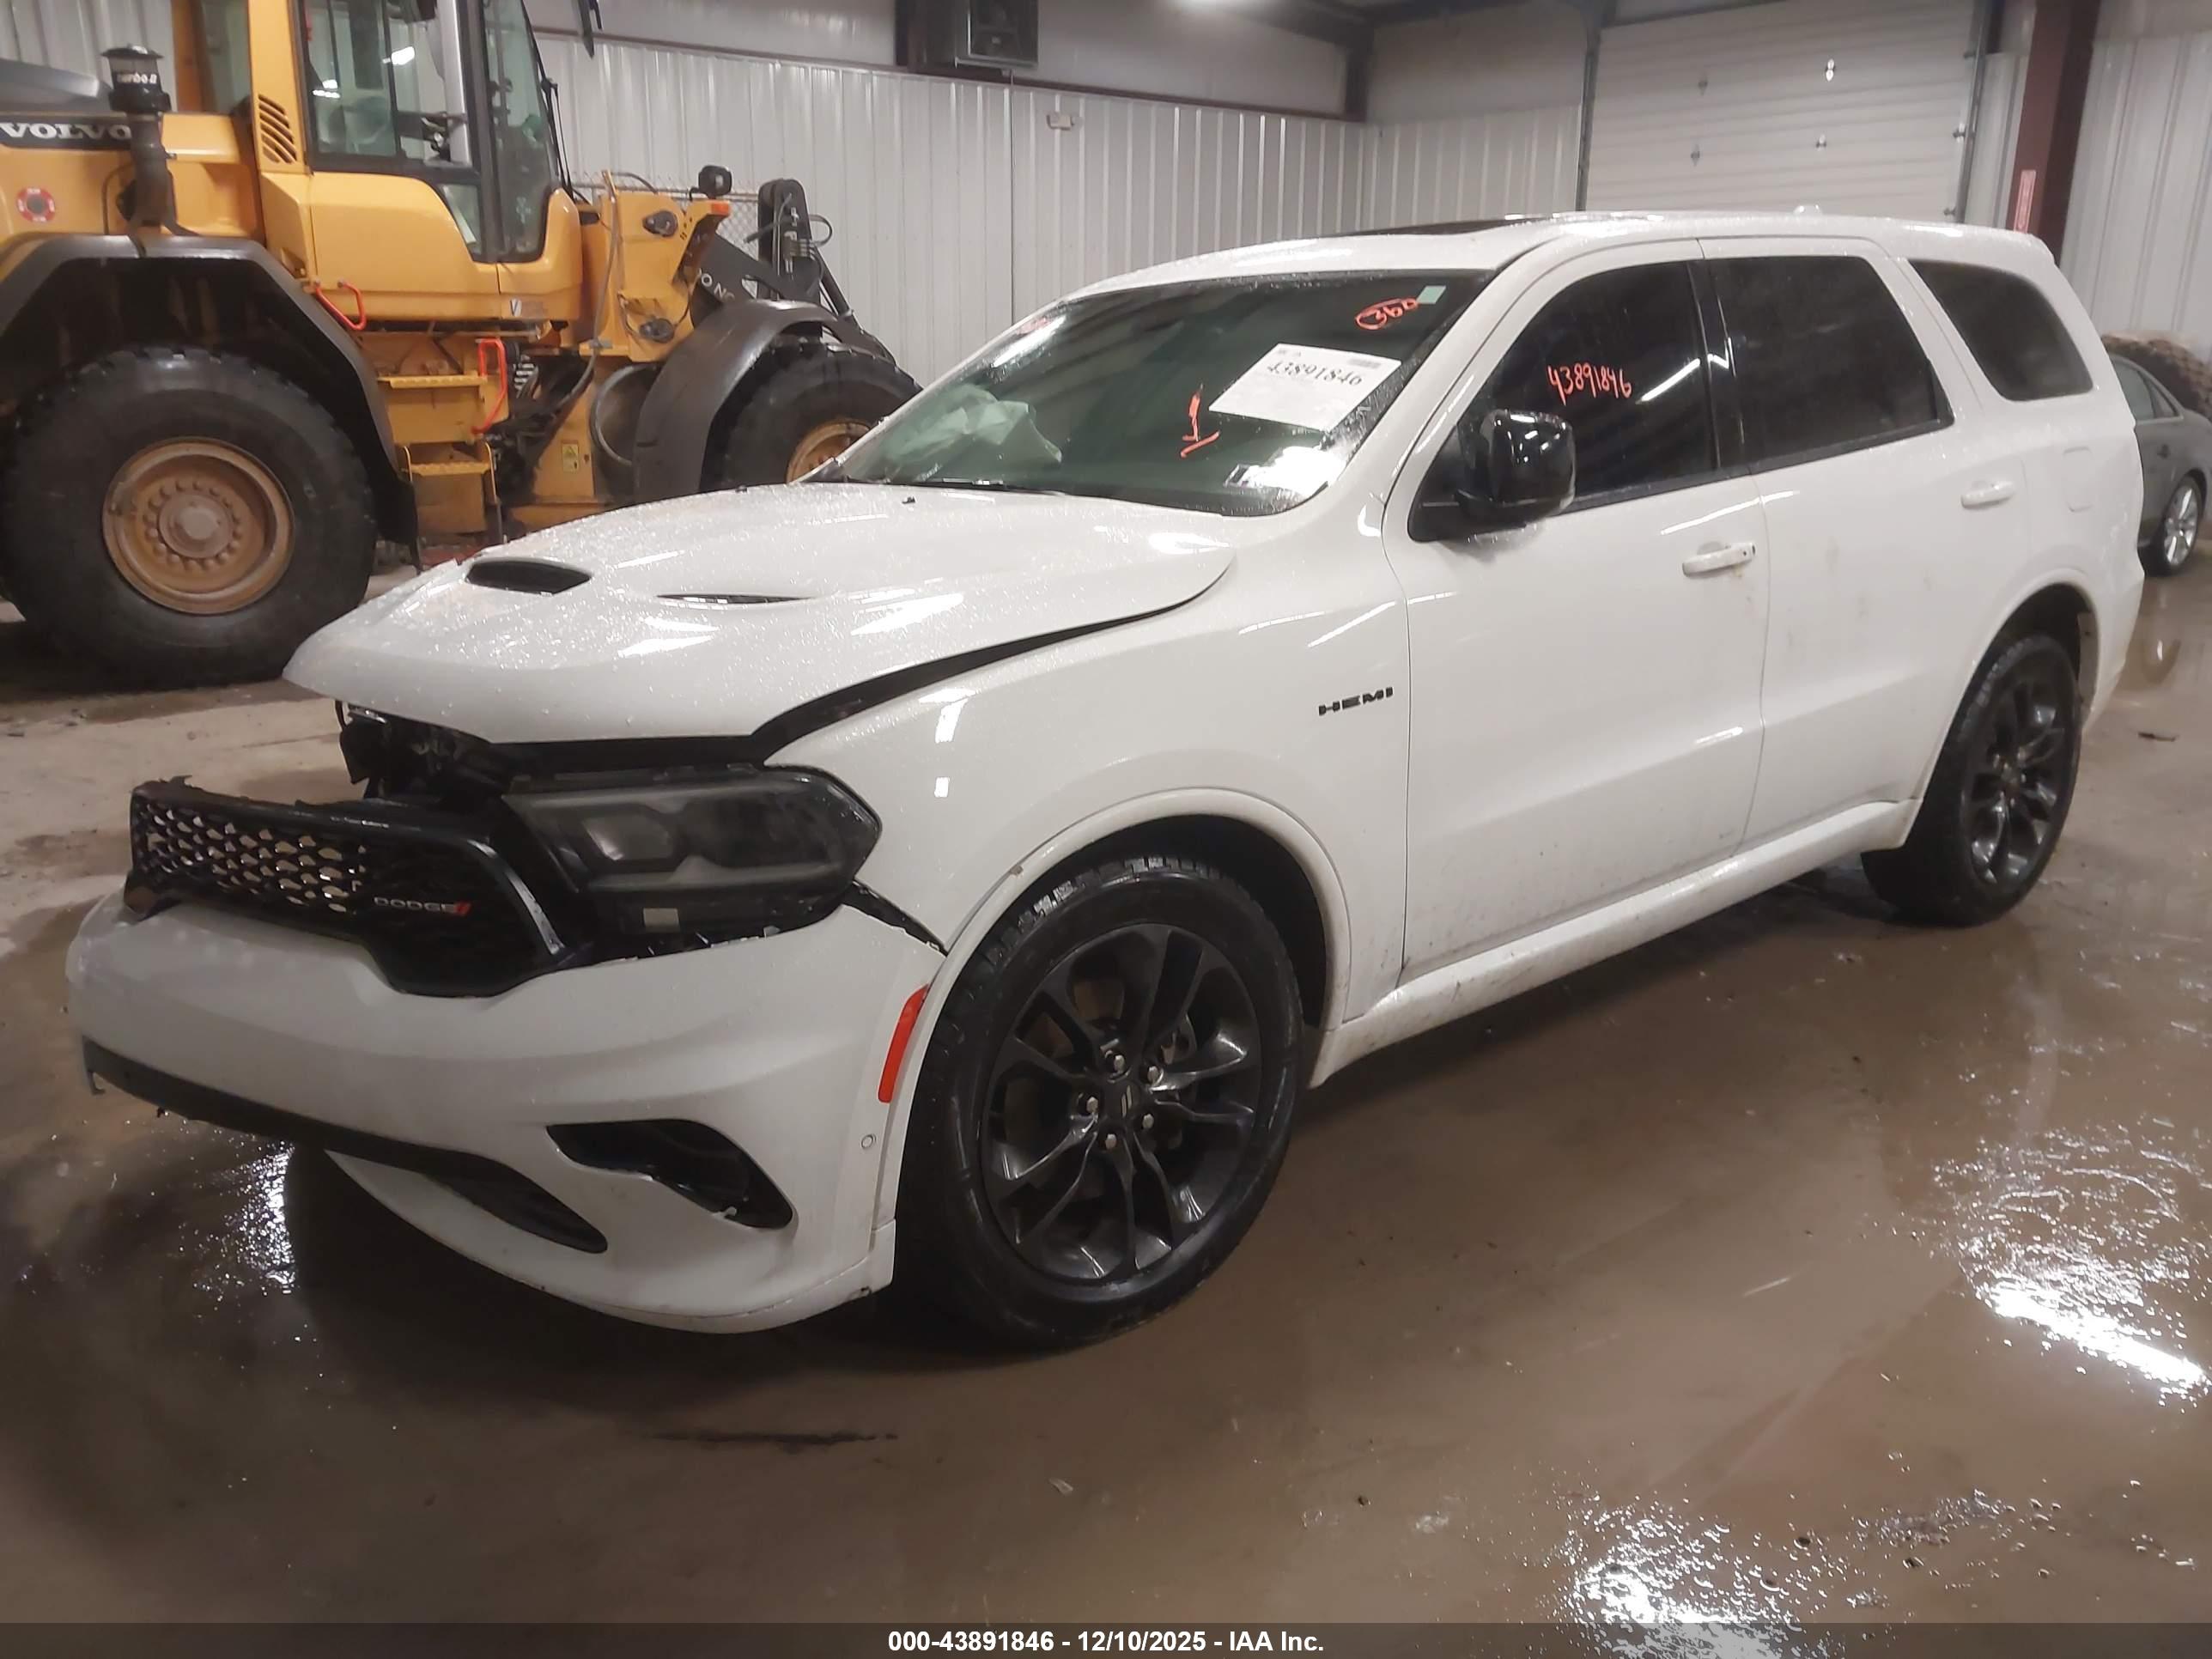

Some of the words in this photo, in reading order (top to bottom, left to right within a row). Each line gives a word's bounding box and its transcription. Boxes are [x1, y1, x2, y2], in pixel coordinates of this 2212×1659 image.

[0, 122, 131, 139] VOLVO
[1547, 362, 1632, 406] 43891846
[1318, 687, 1394, 716] HEMI
[374, 896, 457, 914] DODGE
